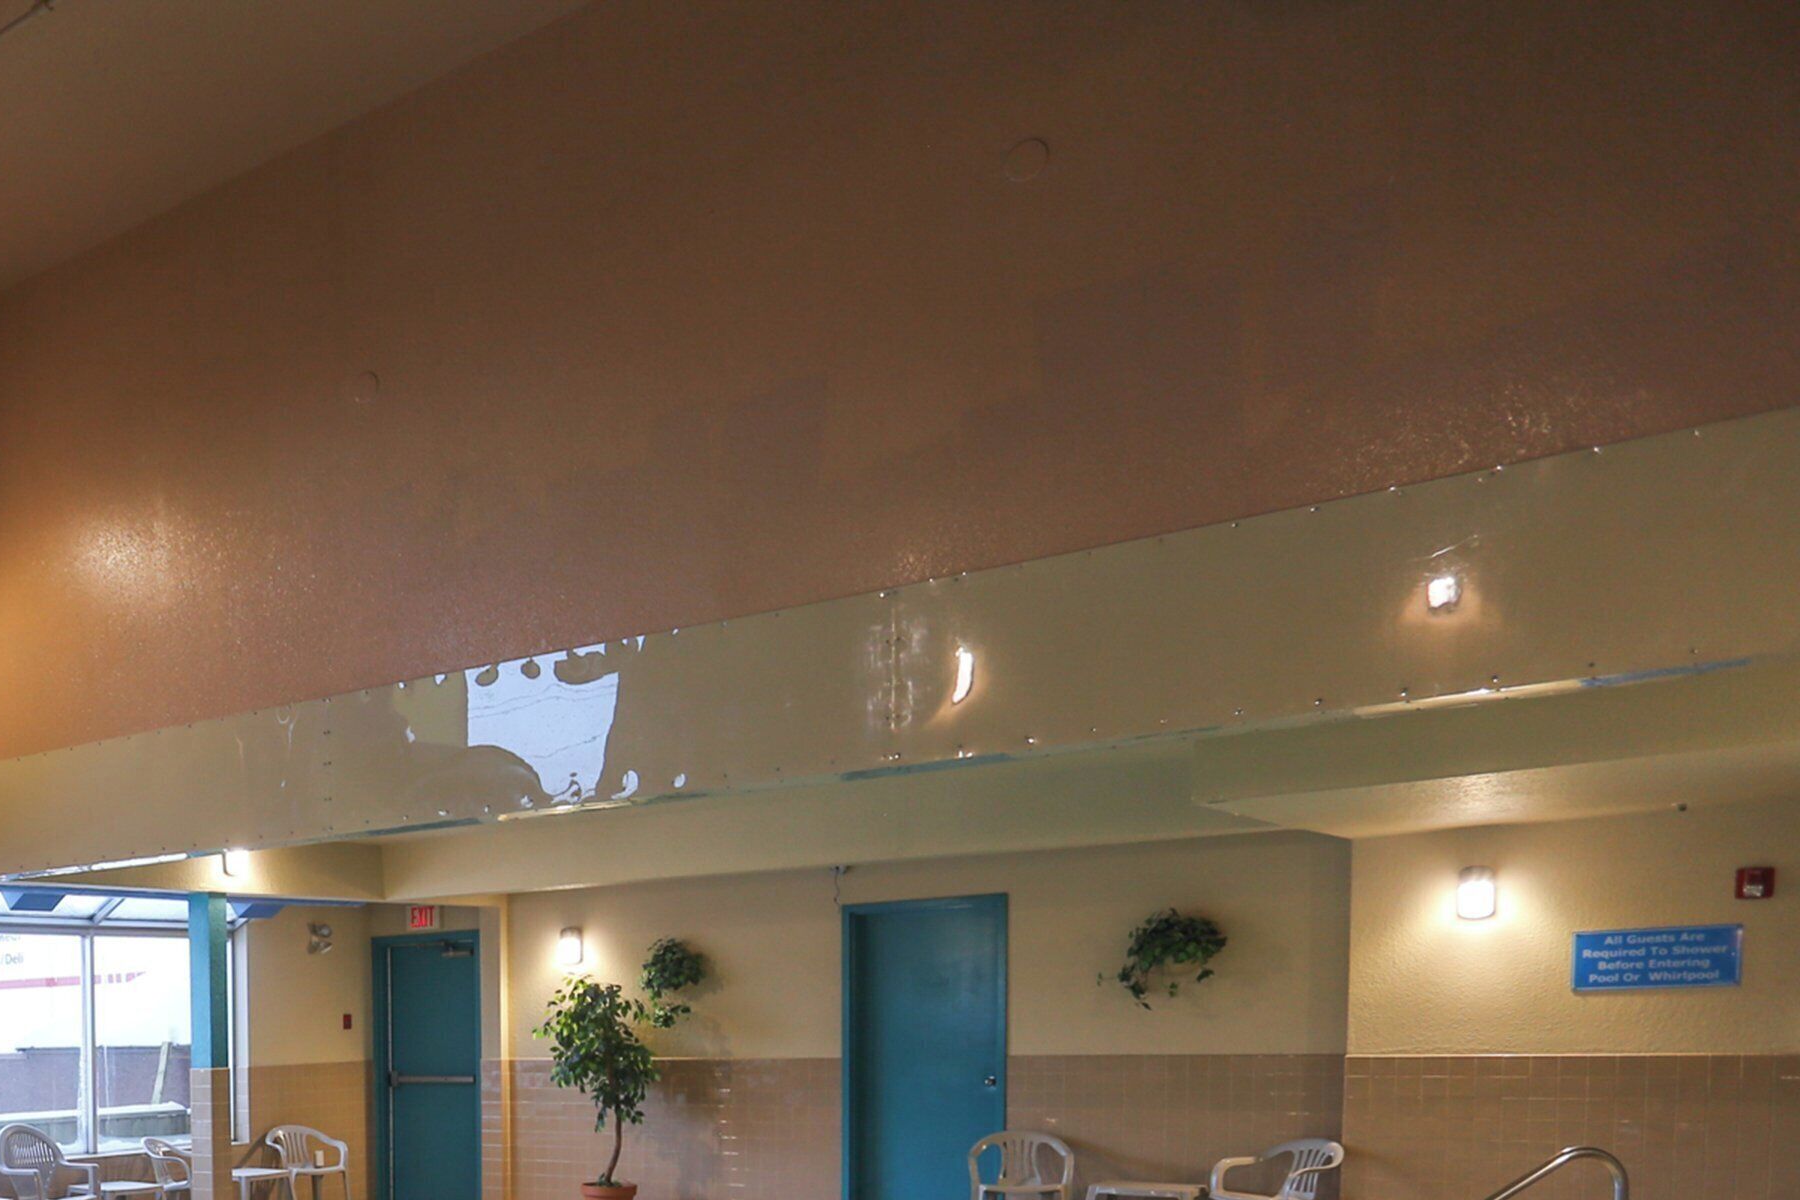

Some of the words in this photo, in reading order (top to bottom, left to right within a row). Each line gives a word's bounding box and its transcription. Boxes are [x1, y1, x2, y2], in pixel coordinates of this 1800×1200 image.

[410, 905, 434, 928] EXIT
[1604, 935, 1623, 945] All
[1626, 933, 1675, 944] Guests
[1680, 931, 1705, 941] Are
[1582, 947, 1646, 959] Required
[1651, 946, 1668, 956] To
[1672, 944, 1727, 955] Shower
[1597, 959, 1644, 971] Before
[1648, 957, 1711, 969] Entering
[1588, 972, 1619, 983] Pool
[1623, 972, 1640, 982] Or
[1650, 969, 1720, 982] Whirlpool
